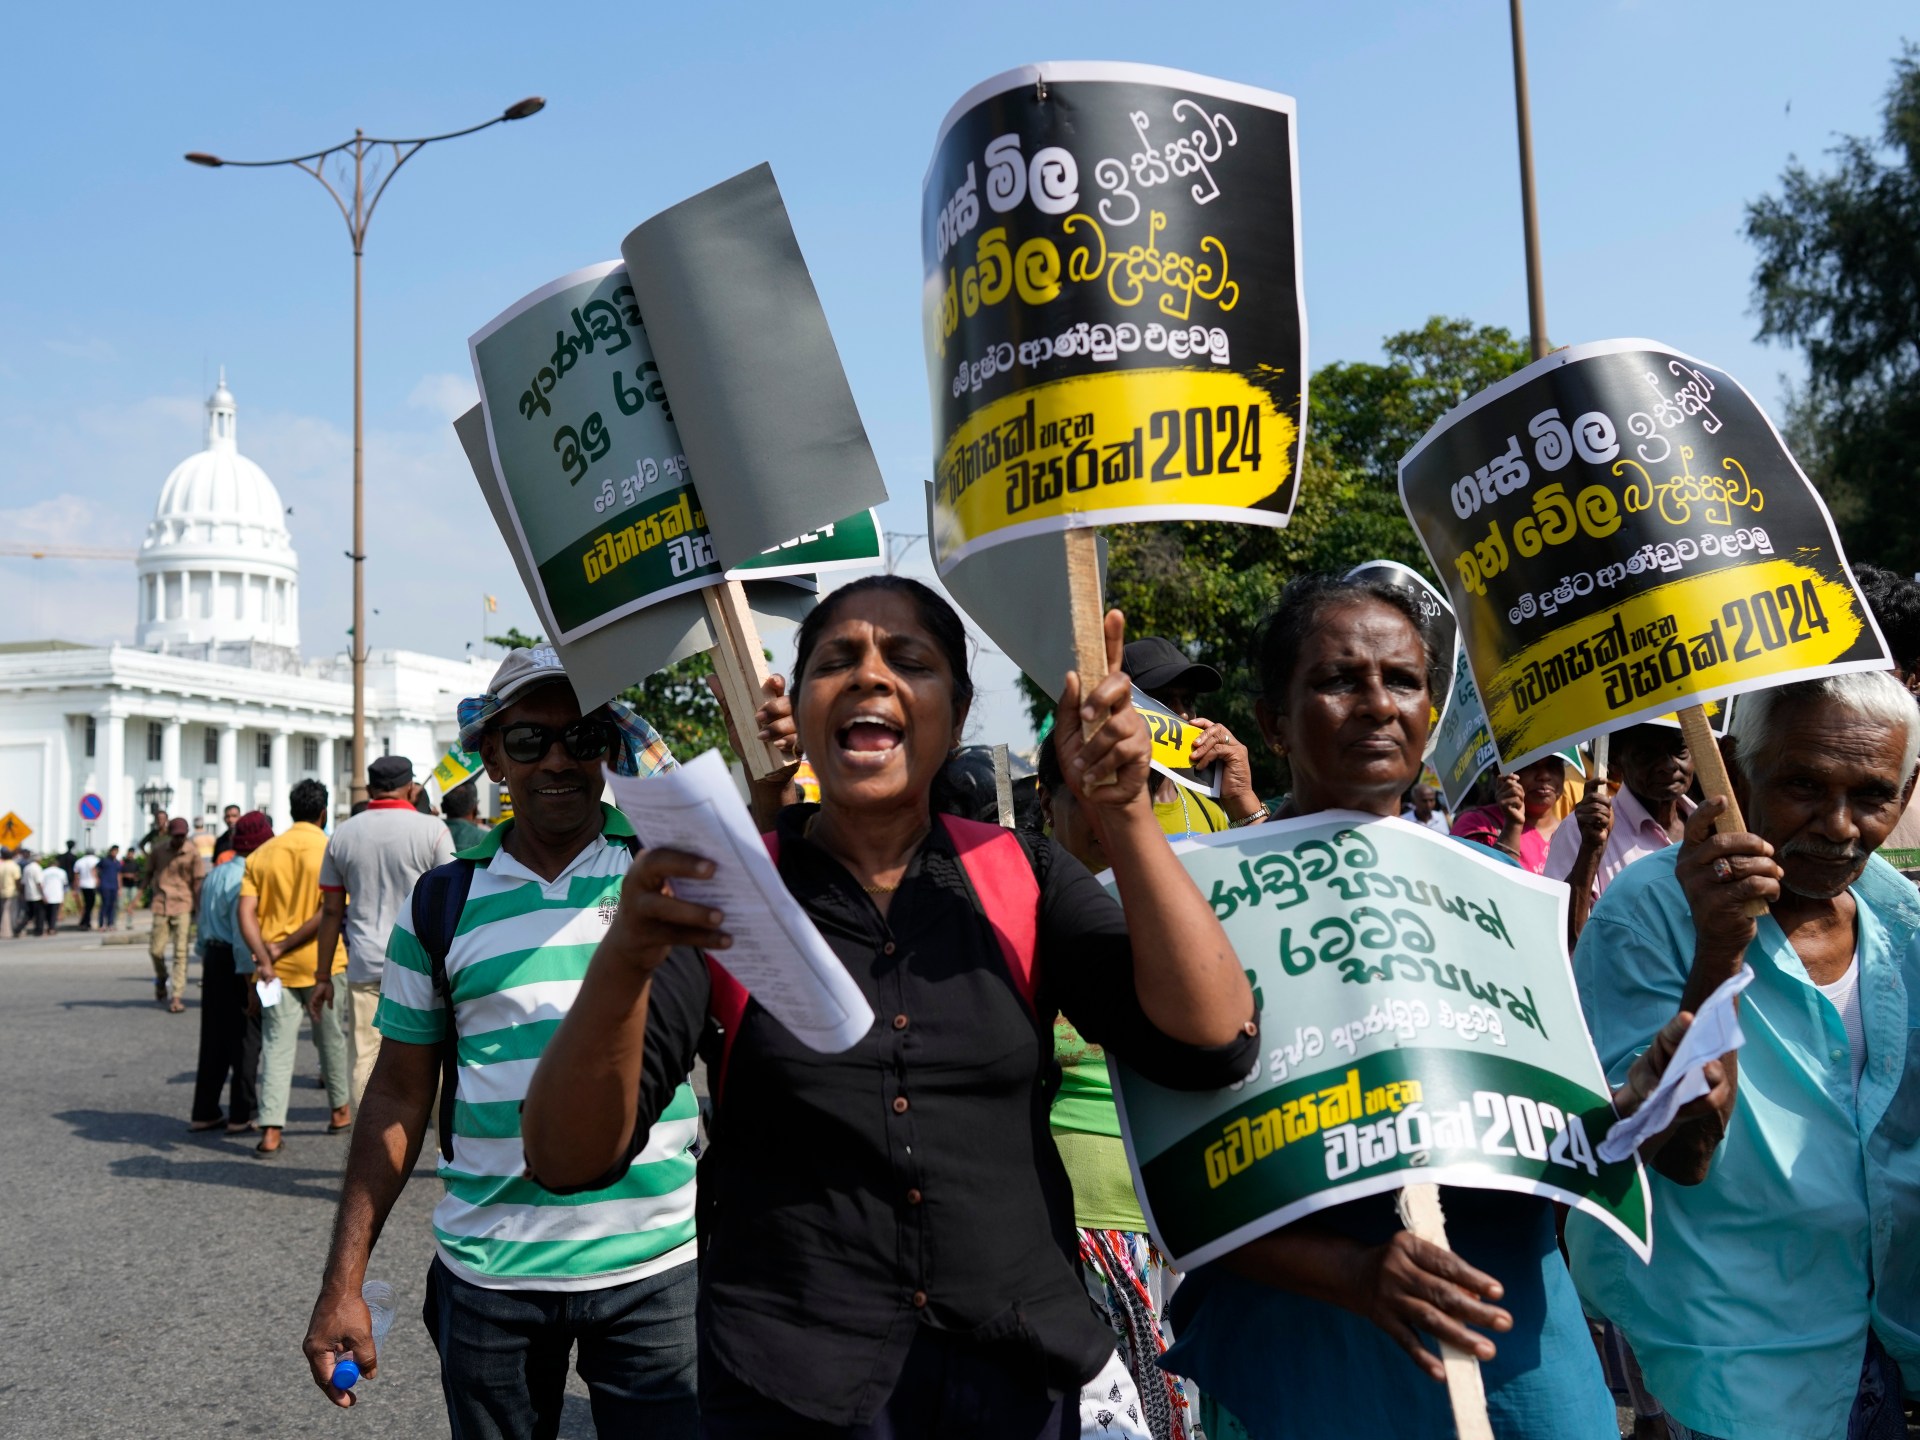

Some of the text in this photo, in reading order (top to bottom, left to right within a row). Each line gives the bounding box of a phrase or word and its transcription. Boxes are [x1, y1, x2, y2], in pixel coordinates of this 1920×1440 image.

[984, 133, 1079, 215] මිල
[1095, 98, 1239, 226] ඉස්සුවා
[962, 227, 1062, 318] වේල
[1063, 209, 1240, 321] බැස්සුවා
[952, 321, 1231, 399] මේ දුෂ්ට ආණ්ඩුව එළවමු
[947, 398, 1094, 506] වෙනසක් හදන
[1005, 404, 1261, 516] වසරක් 2024
[1450, 360, 1723, 520] ගෑස් මිල ඉස්සුවා
[582, 492, 694, 585] වෙනසක්
[594, 478, 616, 513] මේ
[1454, 444, 1764, 597] තුන් වේල බැස්සුවා
[1508, 526, 1775, 625] මේ දුෂ්ට ආණ්ඩුව එළවමු
[1511, 612, 1630, 715] වෙනසක්
[1629, 613, 1678, 650] හදන
[1601, 578, 1831, 711] වසරක් 2024
[1208, 829, 1378, 921] ණ්ඩුවම
[1280, 906, 1435, 976] රටටම
[1331, 998, 1430, 1055] ආණ්ඩුව
[1438, 999, 1507, 1046] එළවමු
[1204, 1068, 1363, 1190] වෙනසක්
[1364, 1080, 1423, 1113] හදන
[1323, 1090, 1599, 1181] වසරක් 2024
